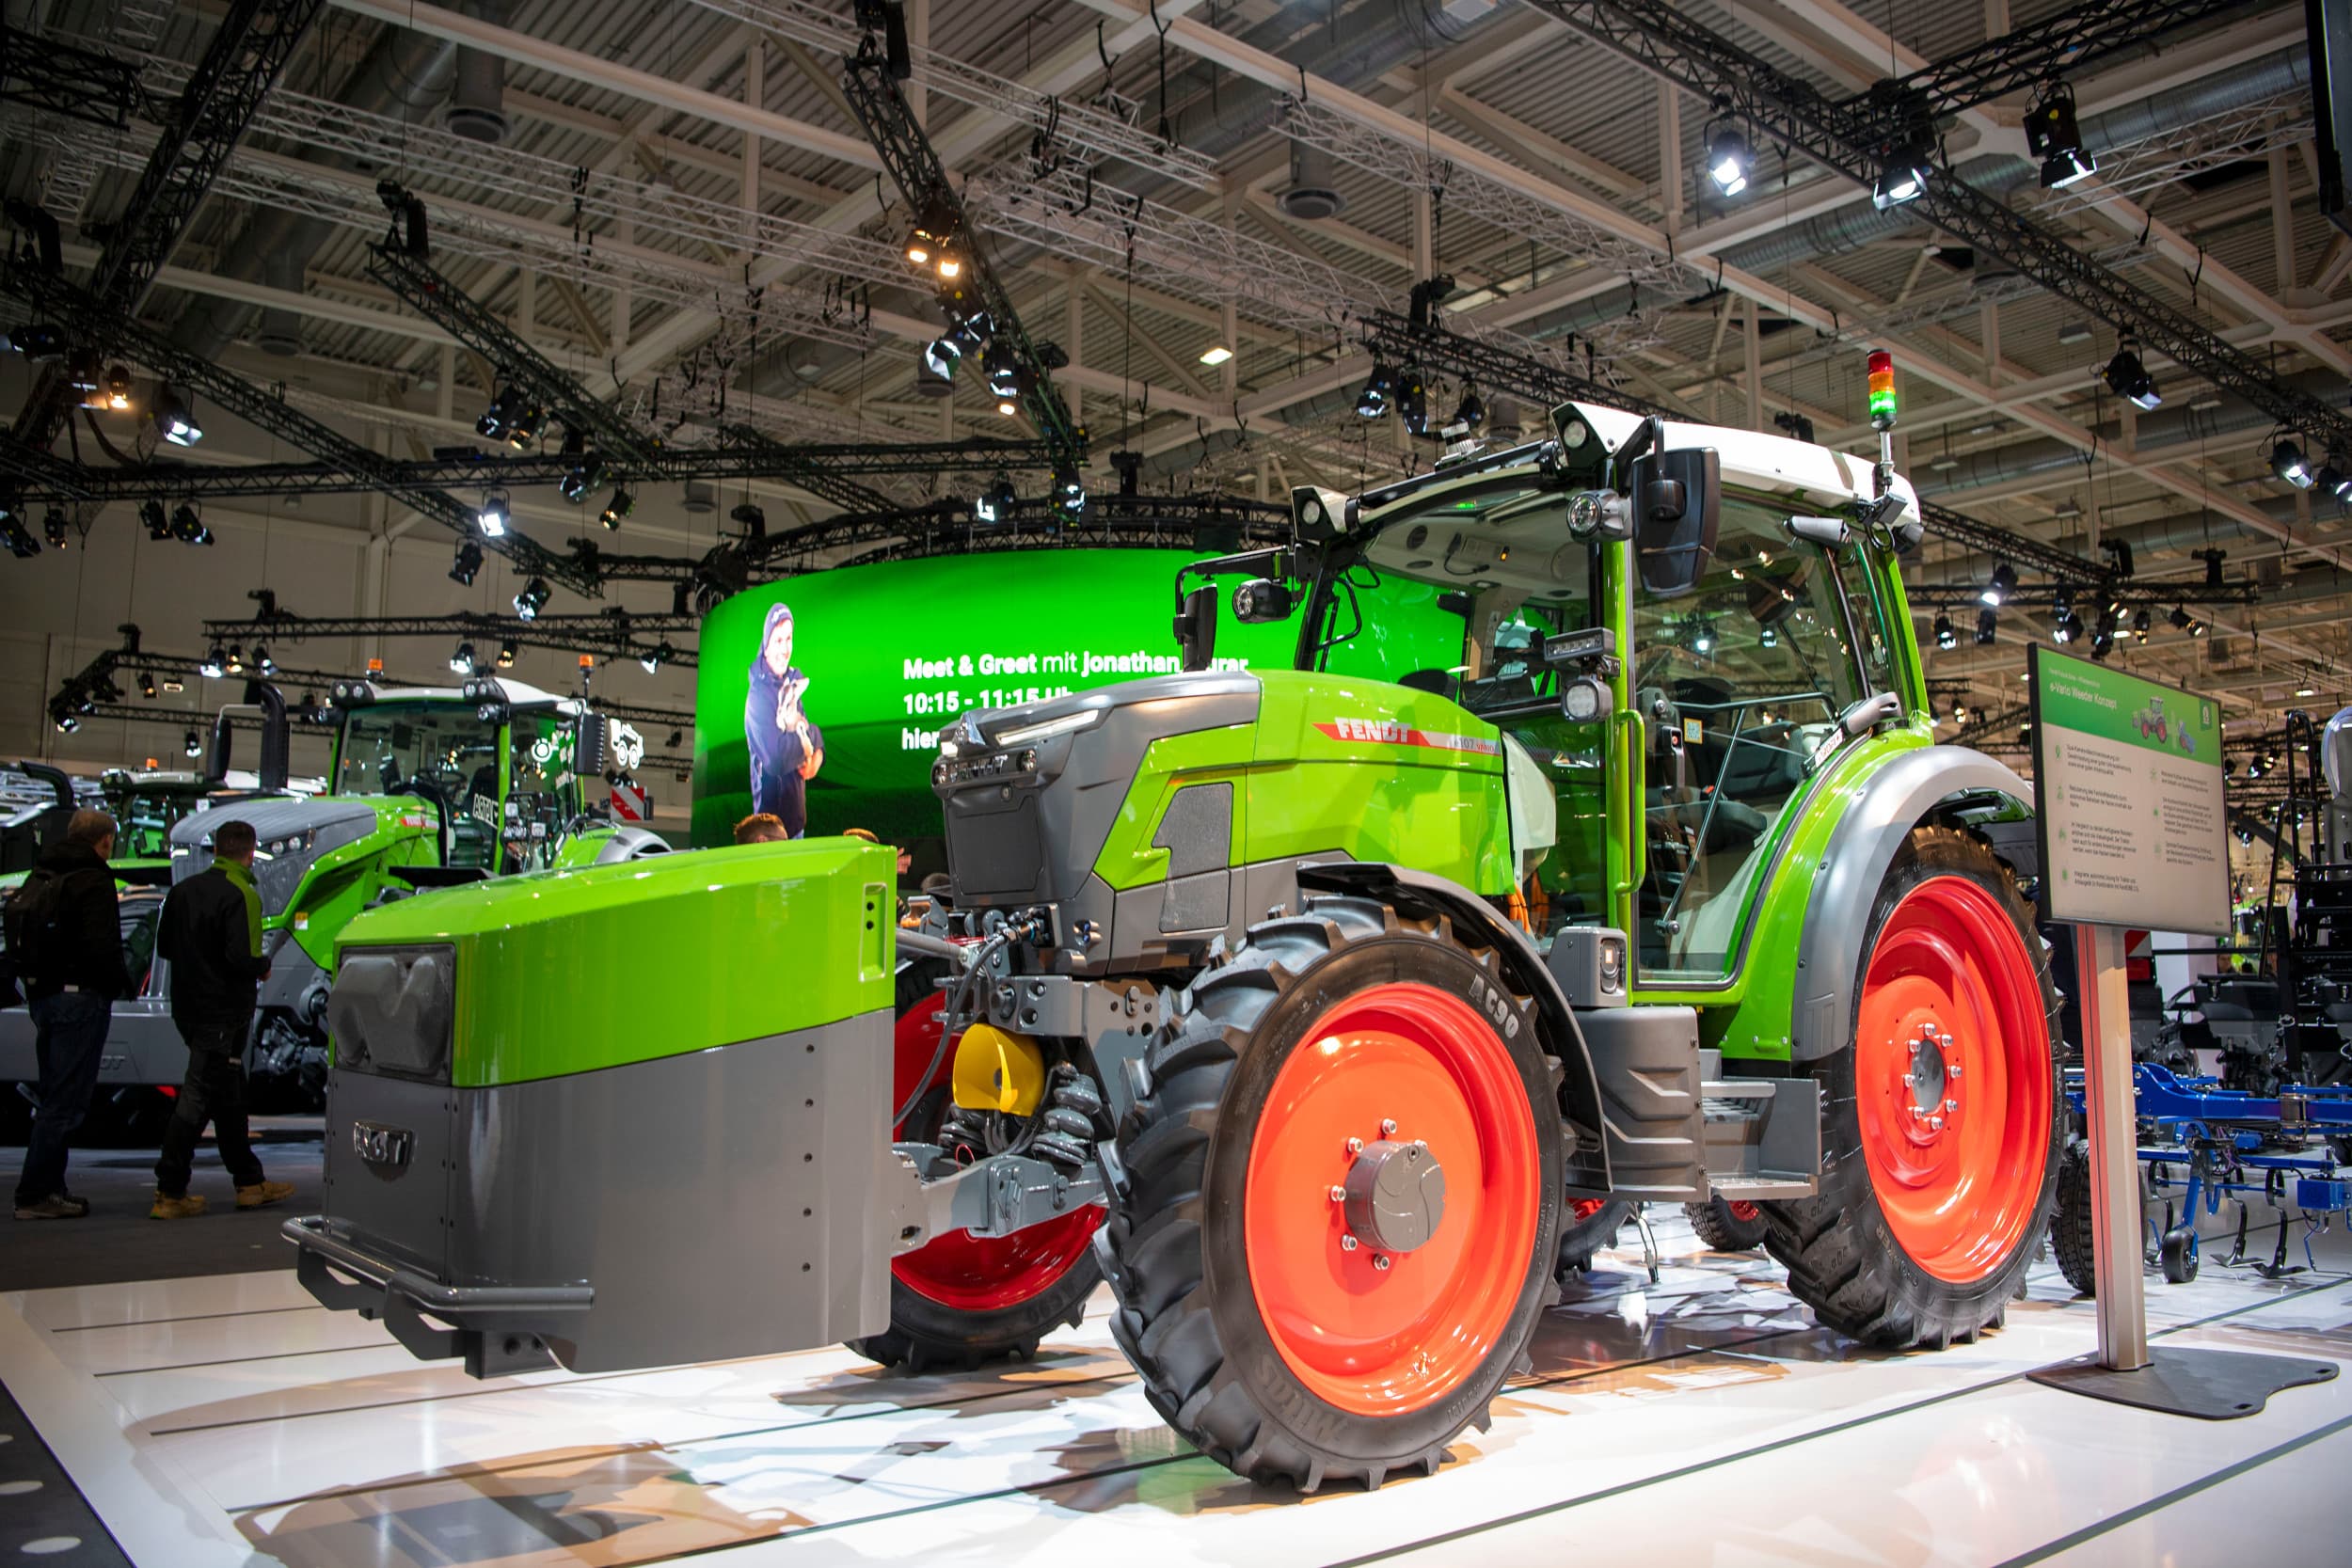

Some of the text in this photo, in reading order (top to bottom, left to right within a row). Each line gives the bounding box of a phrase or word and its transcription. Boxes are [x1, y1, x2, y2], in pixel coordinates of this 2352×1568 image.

[904, 657, 954, 679] Meet
[958, 655, 974, 676] &
[978, 653, 1037, 675] Greet
[1042, 651, 1077, 673] mit
[903, 690, 960, 715] 10:15
[963, 697, 974, 705] -
[901, 728, 940, 750] hier
[1334, 717, 1412, 743] FENDT
[1468, 974, 1519, 1039] AC90
